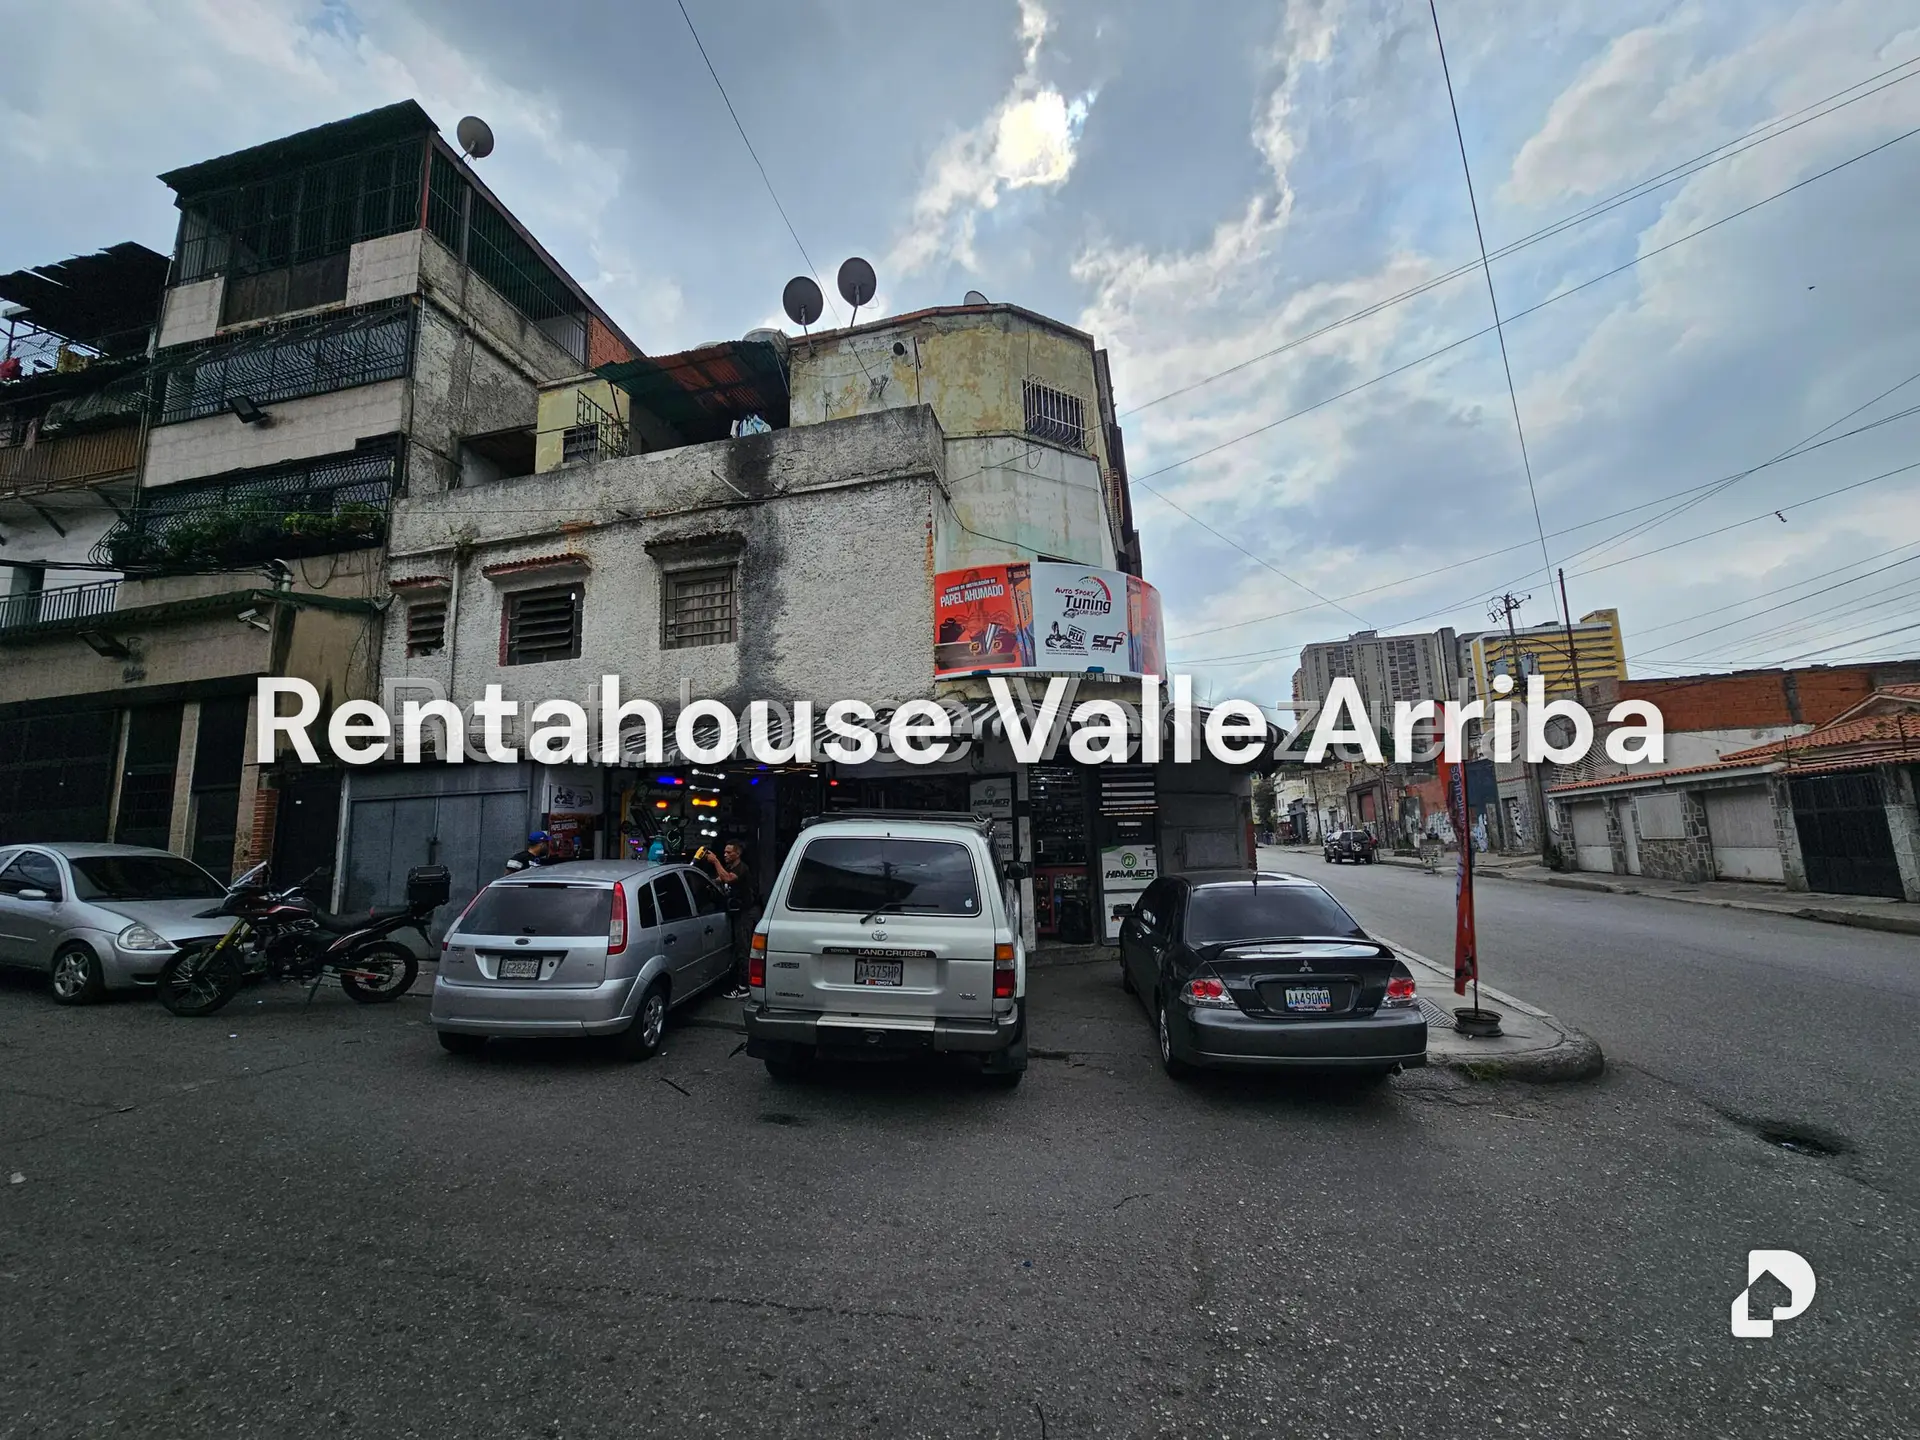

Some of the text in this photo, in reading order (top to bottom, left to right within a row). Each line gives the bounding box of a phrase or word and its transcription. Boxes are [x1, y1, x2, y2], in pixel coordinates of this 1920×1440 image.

[940, 584, 1005, 608] PAPEL AHUMADO
[1074, 588, 1096, 597] SPORT
[1064, 594, 1112, 614] Tuning
[1105, 869, 1155, 879] HAMMER
[858, 948, 885, 956] LAND
[885, 949, 928, 958] CRUISER
[858, 964, 900, 979] AA375HP
[1288, 991, 1331, 1005] AA490KH
